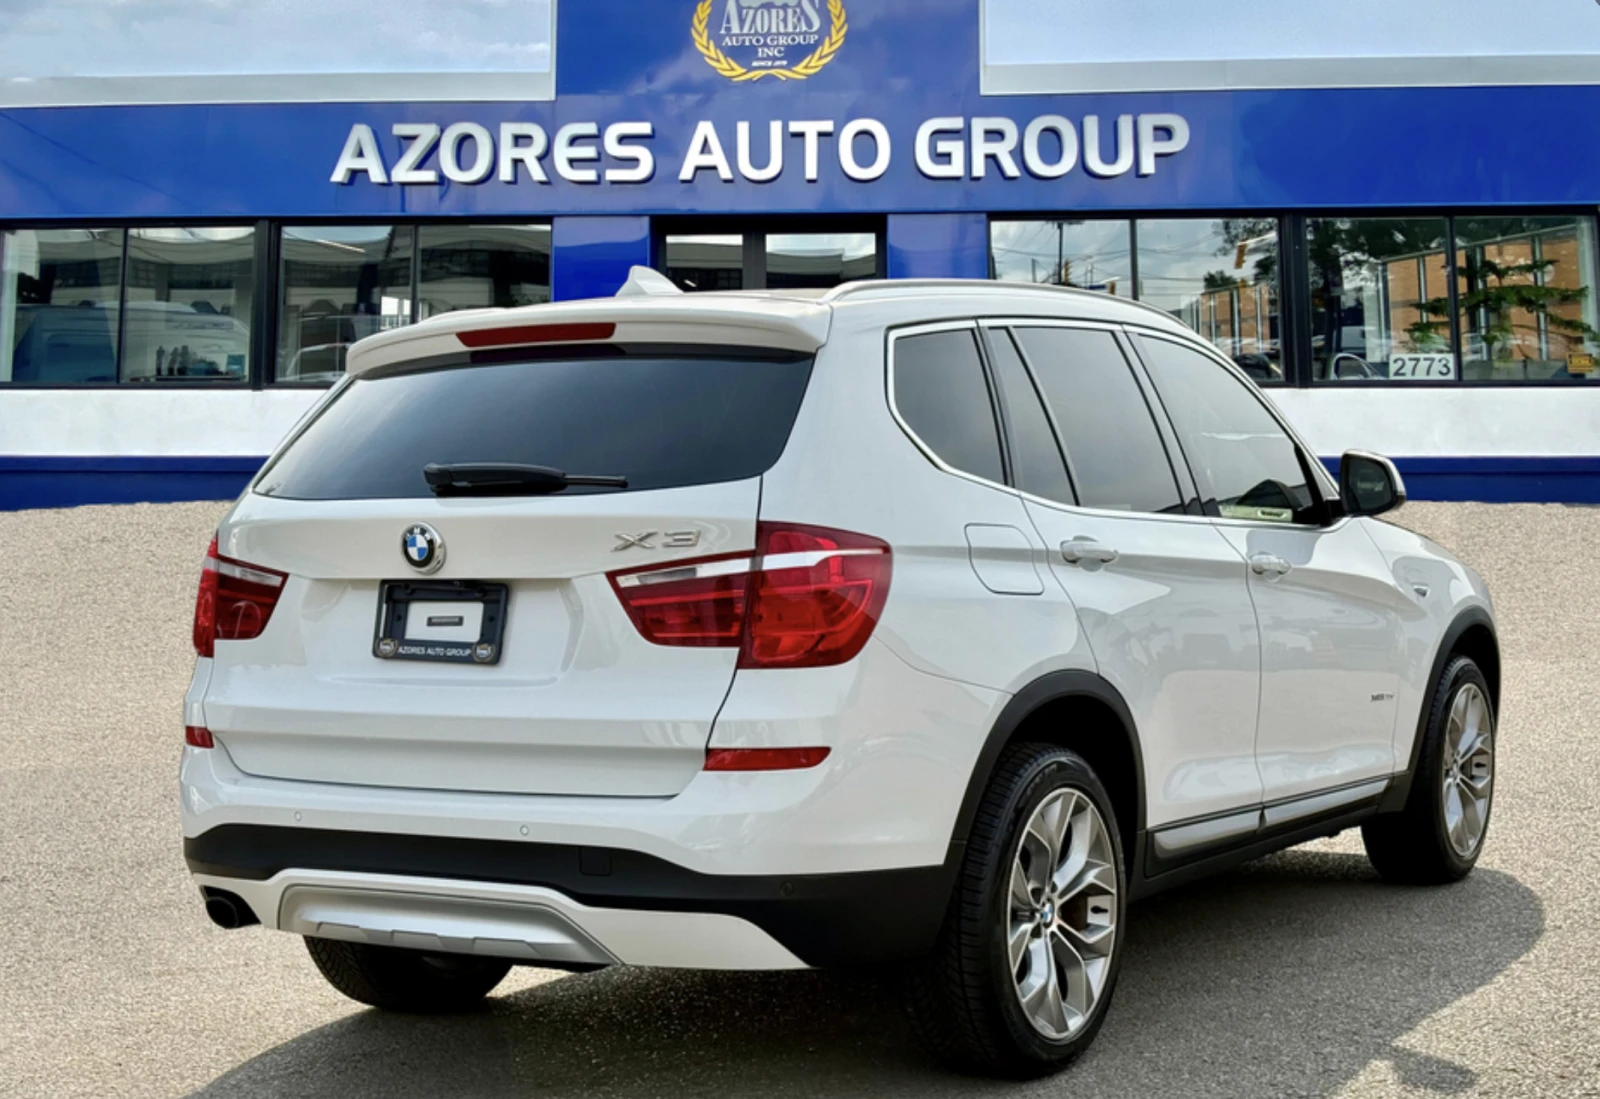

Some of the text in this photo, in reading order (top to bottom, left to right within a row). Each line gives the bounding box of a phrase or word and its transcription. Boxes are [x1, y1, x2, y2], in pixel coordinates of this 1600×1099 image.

[719, 0, 821, 34] AZORES
[722, 35, 818, 46] AUTO GROUP
[757, 47, 785, 58] INC
[330, 113, 1191, 185] AZORES AUTO GROUP
[1392, 357, 1451, 376] 2773
[397, 646, 472, 657] AZORES AUTO GROUP
